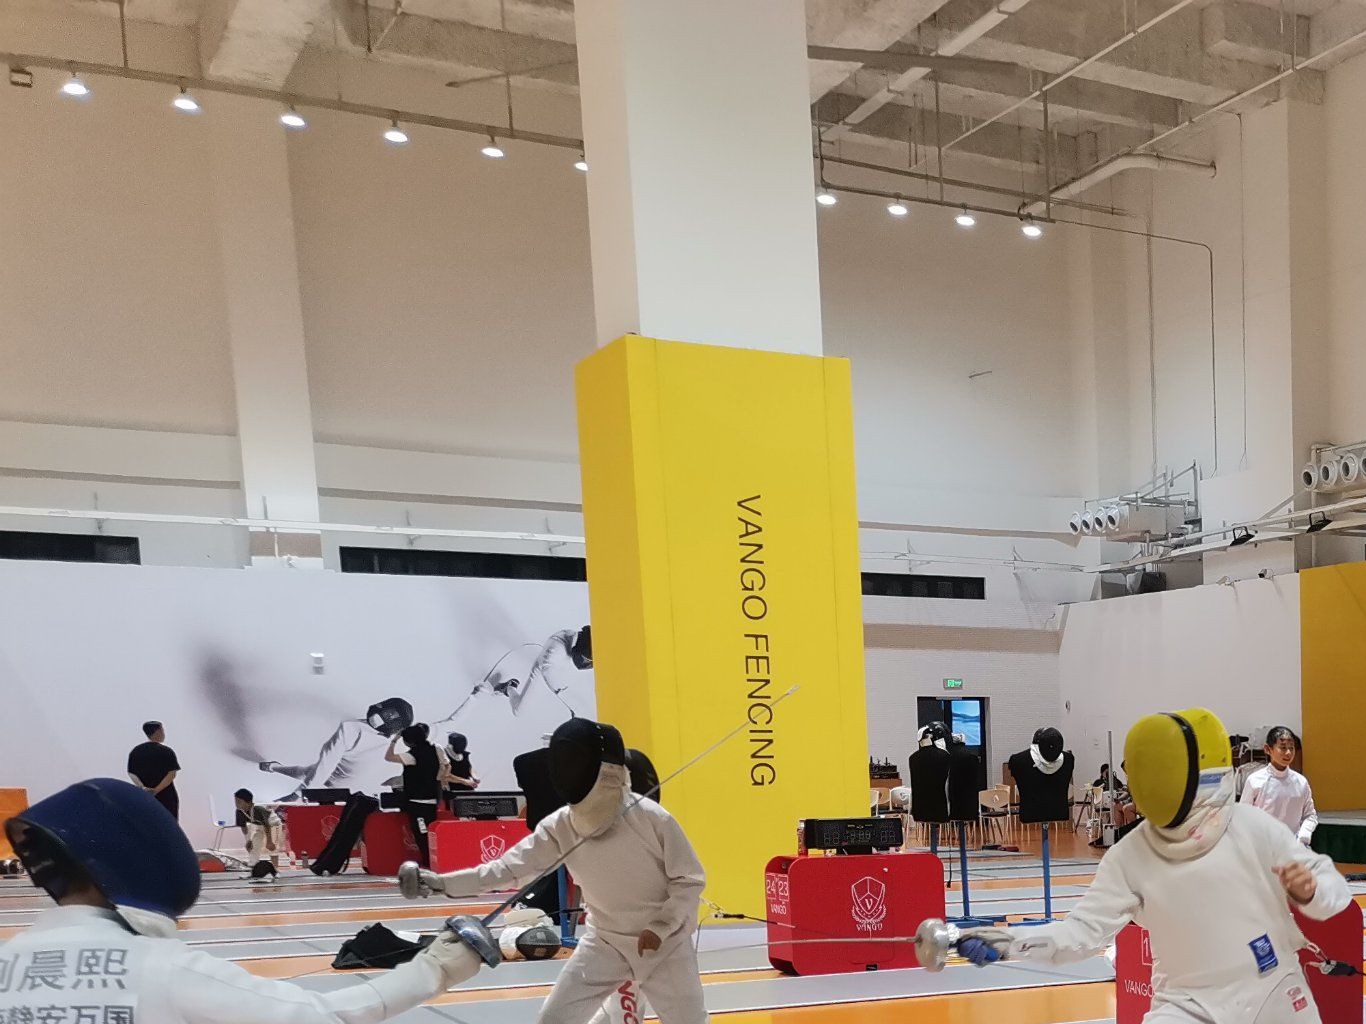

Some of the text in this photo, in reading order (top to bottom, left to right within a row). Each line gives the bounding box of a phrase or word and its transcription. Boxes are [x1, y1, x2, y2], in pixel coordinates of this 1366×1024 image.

[736, 494, 777, 787] VANGO FENCING
[766, 879, 789, 896] 24 23
[1125, 979, 1153, 998] VANGO
